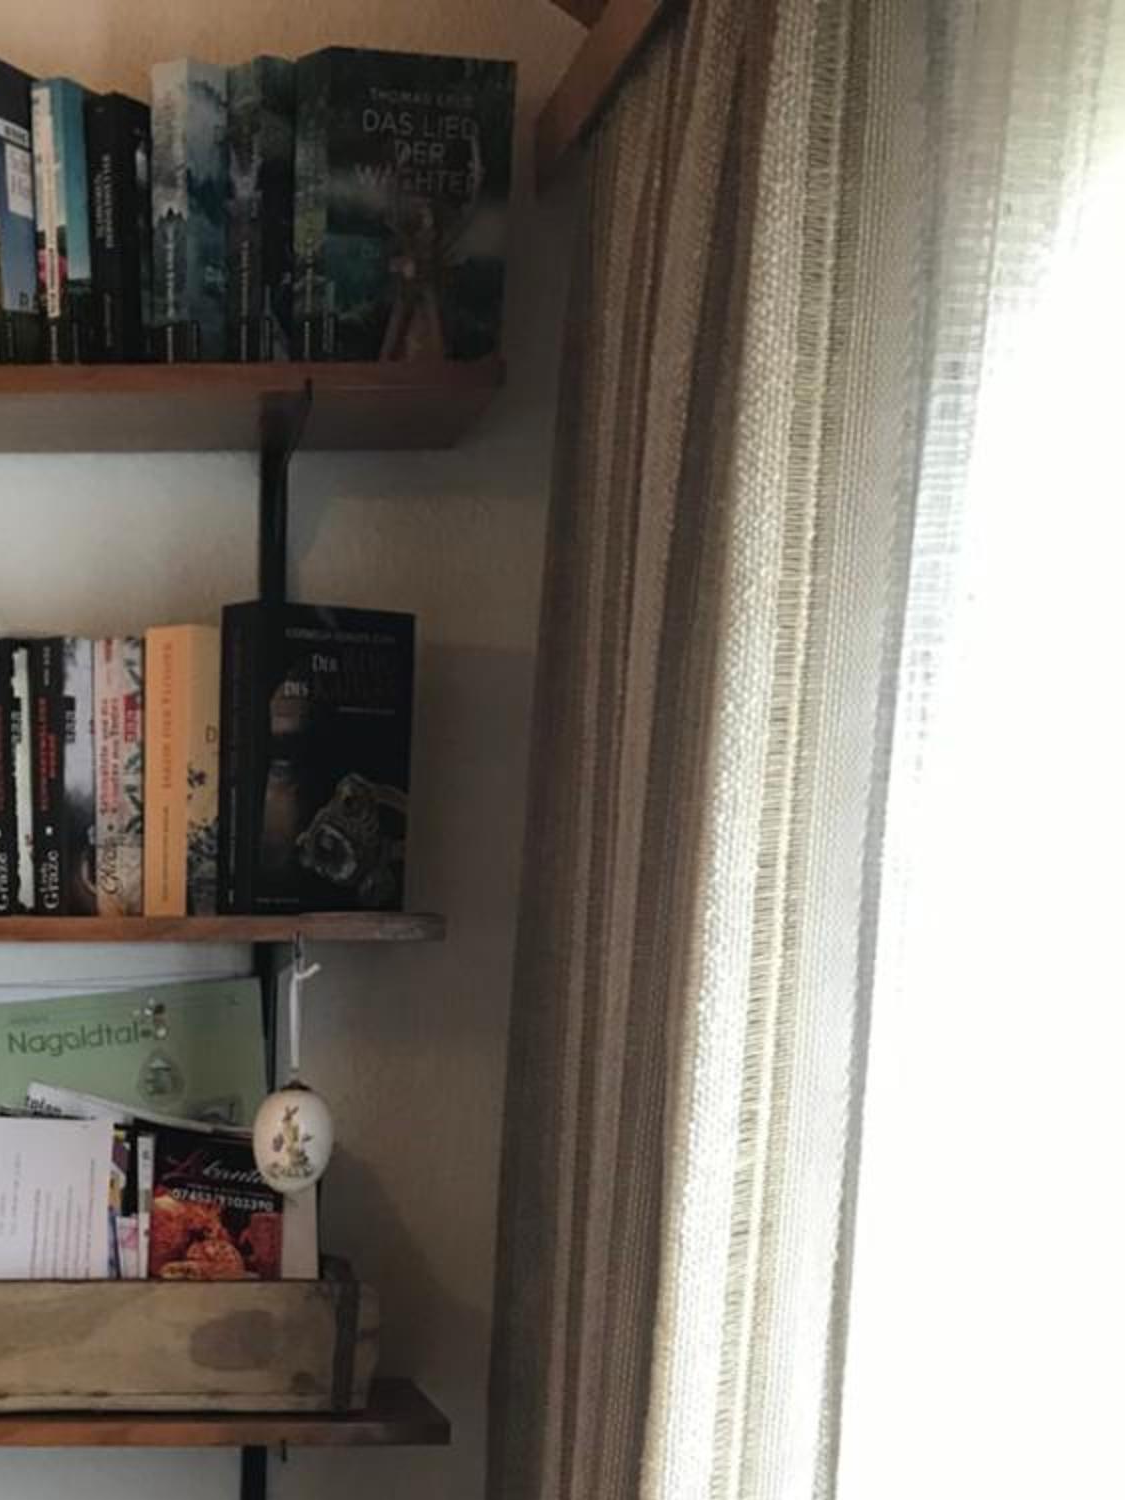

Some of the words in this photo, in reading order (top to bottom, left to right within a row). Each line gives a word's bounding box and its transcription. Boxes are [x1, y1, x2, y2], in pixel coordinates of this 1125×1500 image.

[362, 108, 414, 136] DAS
[423, 114, 478, 141] LIED
[394, 140, 445, 165] DER
[6, 1021, 140, 1057] Nagoldtal
